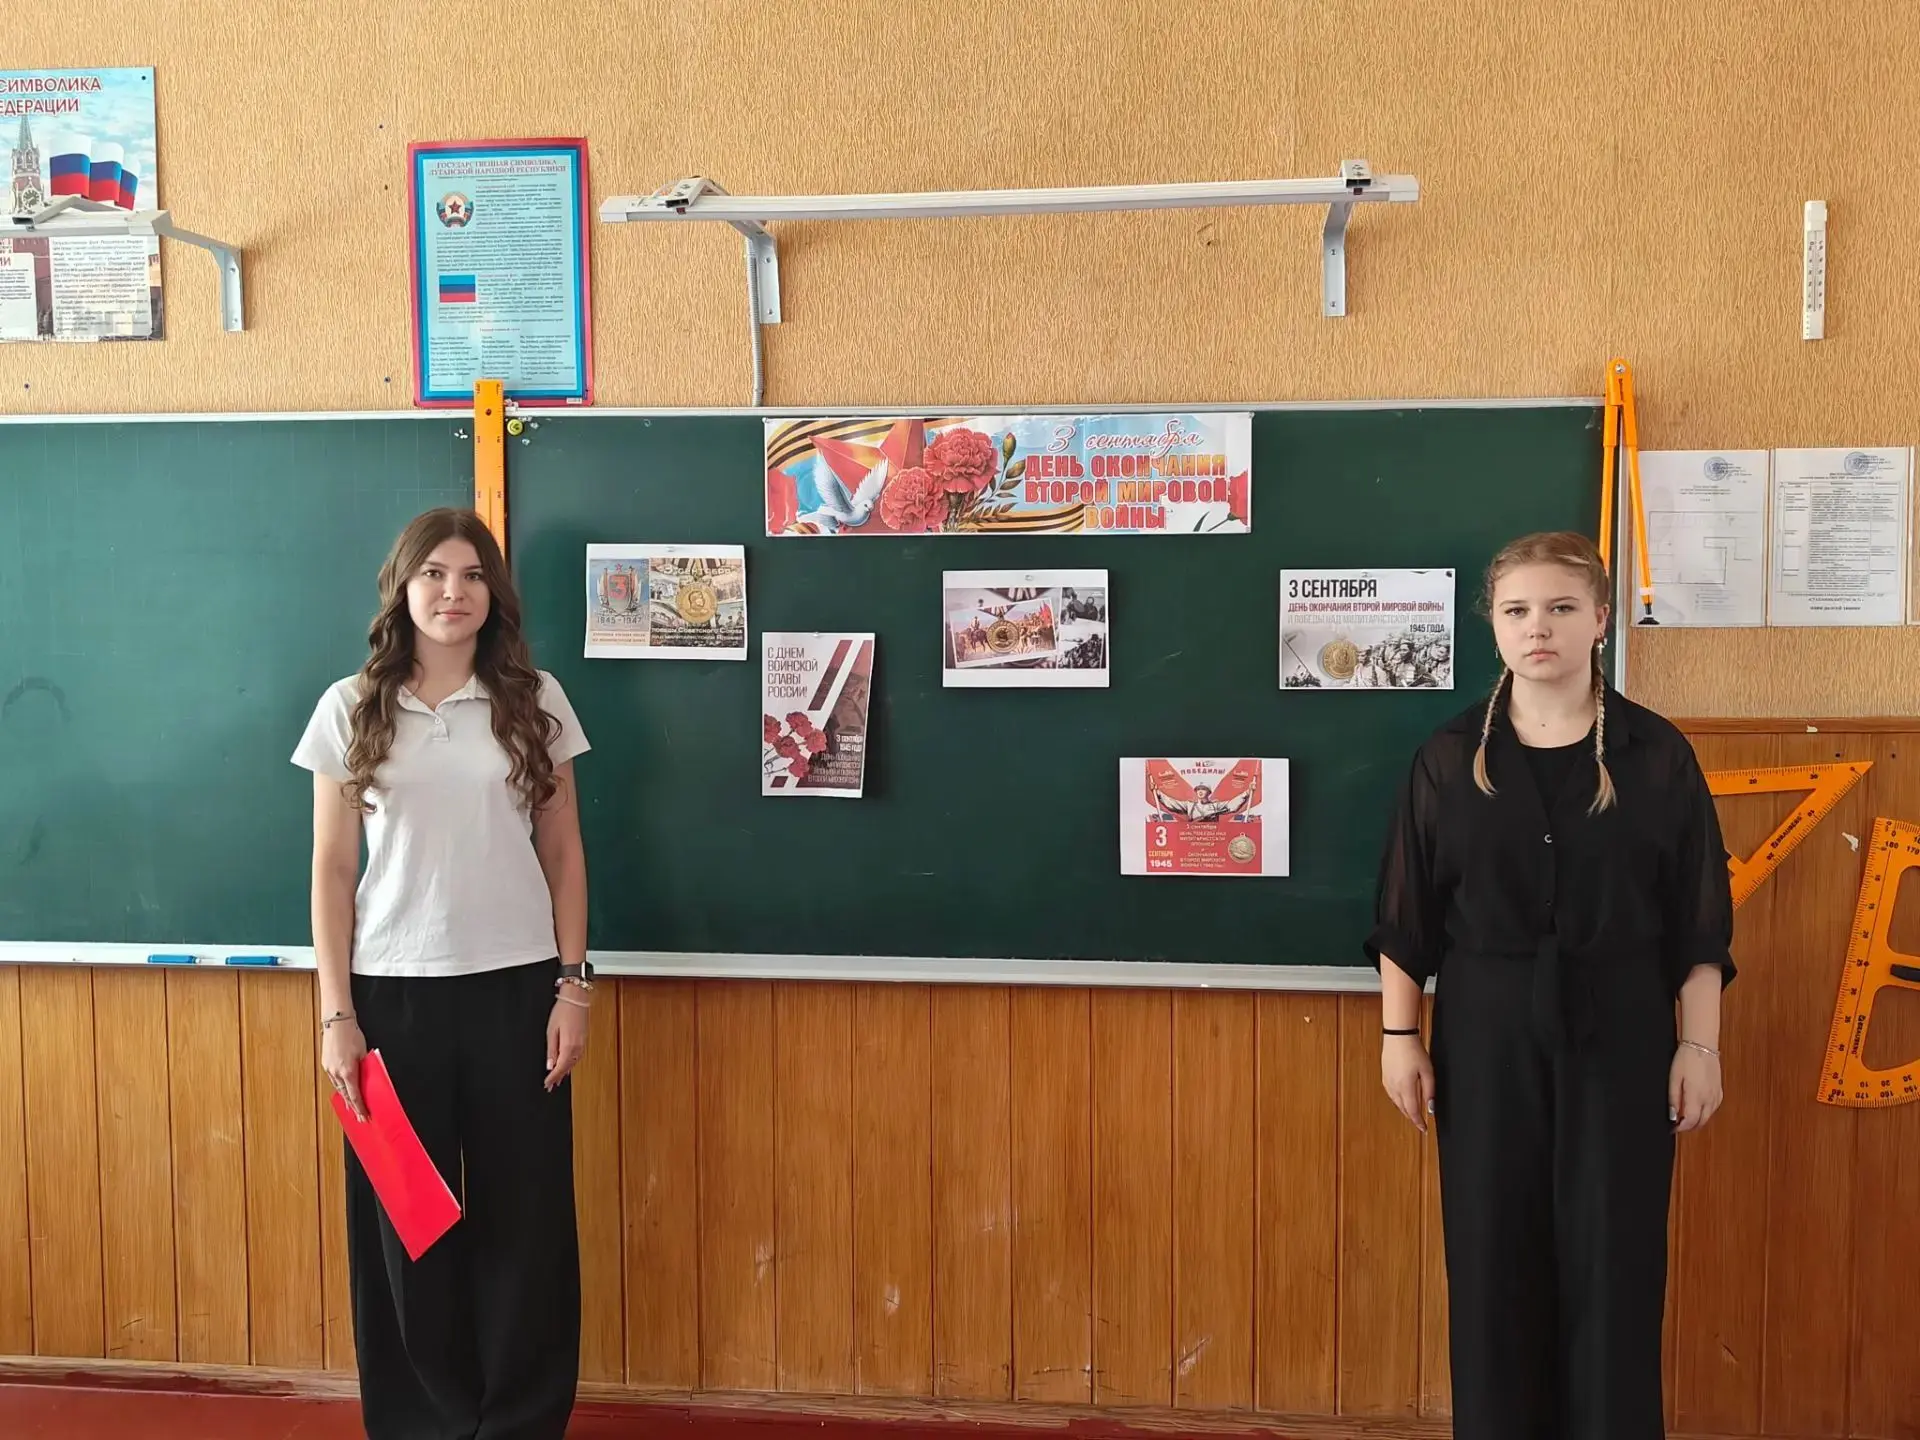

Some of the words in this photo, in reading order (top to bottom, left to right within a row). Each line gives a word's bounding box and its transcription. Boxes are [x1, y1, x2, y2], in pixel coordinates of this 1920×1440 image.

[1048, 425, 1075, 452] 3
[1085, 420, 1204, 457] сентября
[1024, 456, 1084, 480] ДЕНЬ
[1091, 455, 1226, 478] ОКОНЧАНИЯ
[1025, 478, 1109, 503] ВТОРОЙ
[1118, 478, 1228, 503] МИРОВОЙ
[1085, 504, 1166, 528] ВОЙНЫ
[1289, 579, 1298, 598] 3
[1301, 579, 1377, 598] СЕНТЯБРЯ
[1288, 602, 1308, 613] ДЕНЬ
[1309, 602, 1352, 612] ОКОНЧАНИЯ
[1353, 601, 1381, 612] ВТОРОЙ
[1382, 601, 1417, 611] МИРОВОЙ
[1418, 601, 1445, 611] ВОЙНЫ
[1294, 614, 1326, 624] ПОБЕДЫ
[1410, 624, 1426, 632] 1945
[1427, 624, 1445, 633] ГОДА
[768, 647, 774, 658] С
[776, 647, 804, 659] ДНЕМ
[768, 658, 818, 671] ВОИНСКОЙ
[768, 673, 800, 685] СЛАВЫ
[768, 686, 807, 698] РОССИИ!
[1155, 825, 1167, 847] 3
[1149, 860, 1173, 868] 1945
[1881, 1079, 1891, 1087] 20
[1903, 1074, 1912, 1082] 30
